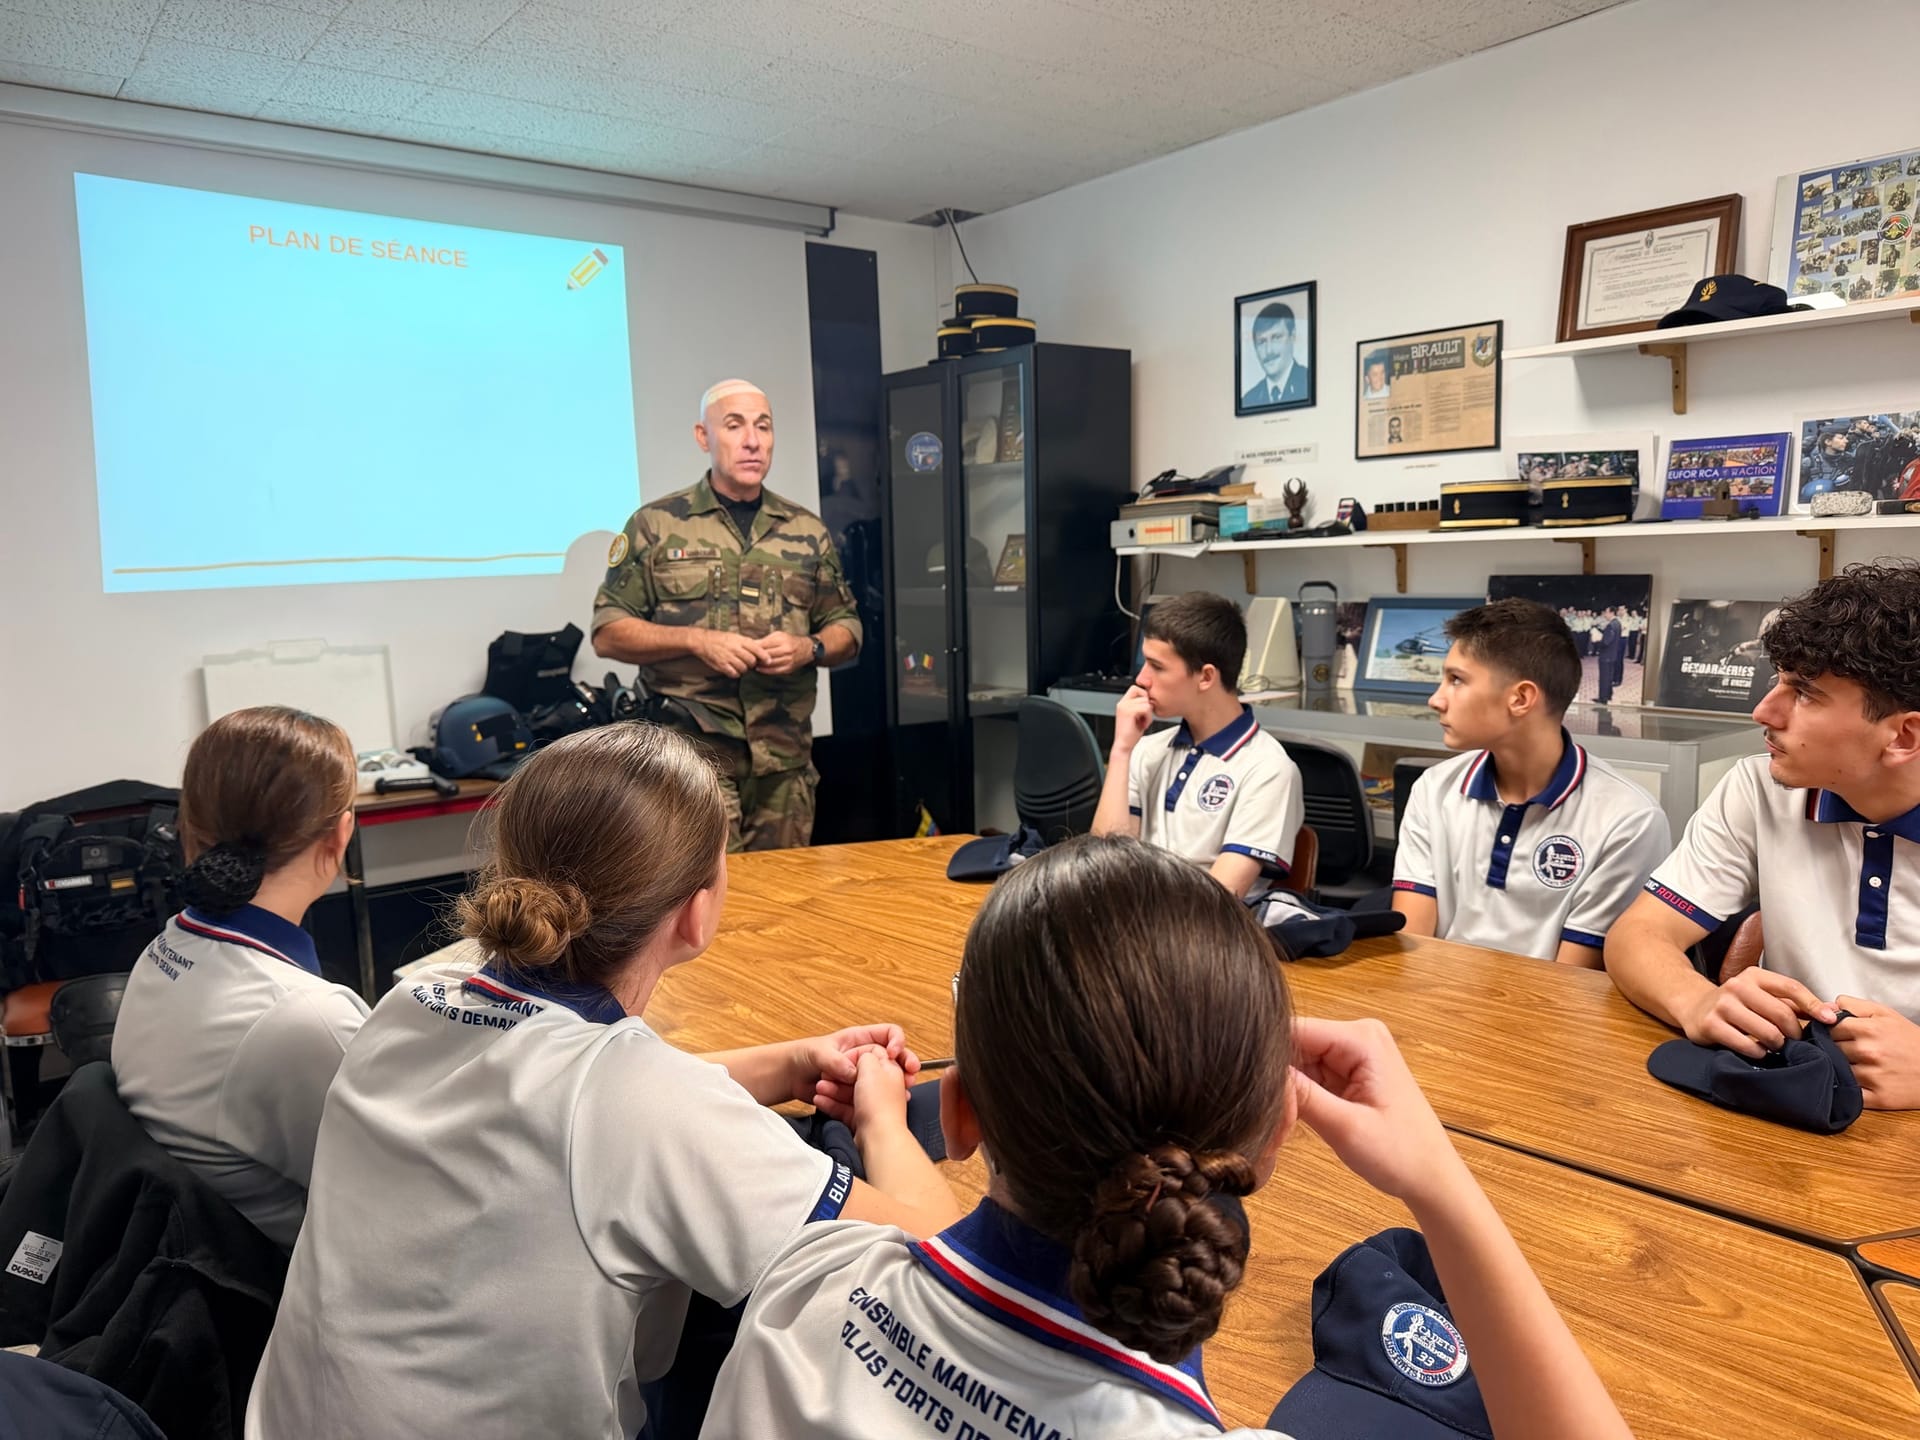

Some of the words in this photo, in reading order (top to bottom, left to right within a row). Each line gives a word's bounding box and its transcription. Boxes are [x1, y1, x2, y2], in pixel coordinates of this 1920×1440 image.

[249, 225, 320, 251] PLAN
[330, 235, 364, 256] DE
[371, 239, 469, 268] SÉANCE
[1411, 340, 1462, 359] BIRAULT
[1668, 469, 1697, 480] EUFOR
[1699, 469, 1719, 478] RCA
[1739, 466, 1777, 476] ACTION
[1656, 886, 1696, 915] ROUGE
[828, 1162, 851, 1204] BLAN
[848, 1286, 933, 1371] ENSEMBLE
[1419, 1325, 1457, 1353] CADETS
[1416, 1351, 1435, 1367] 33
[841, 1320, 889, 1377] PLUS
[883, 1368, 954, 1433] FORTS
[1419, 1370, 1454, 1384] DEMAIN
